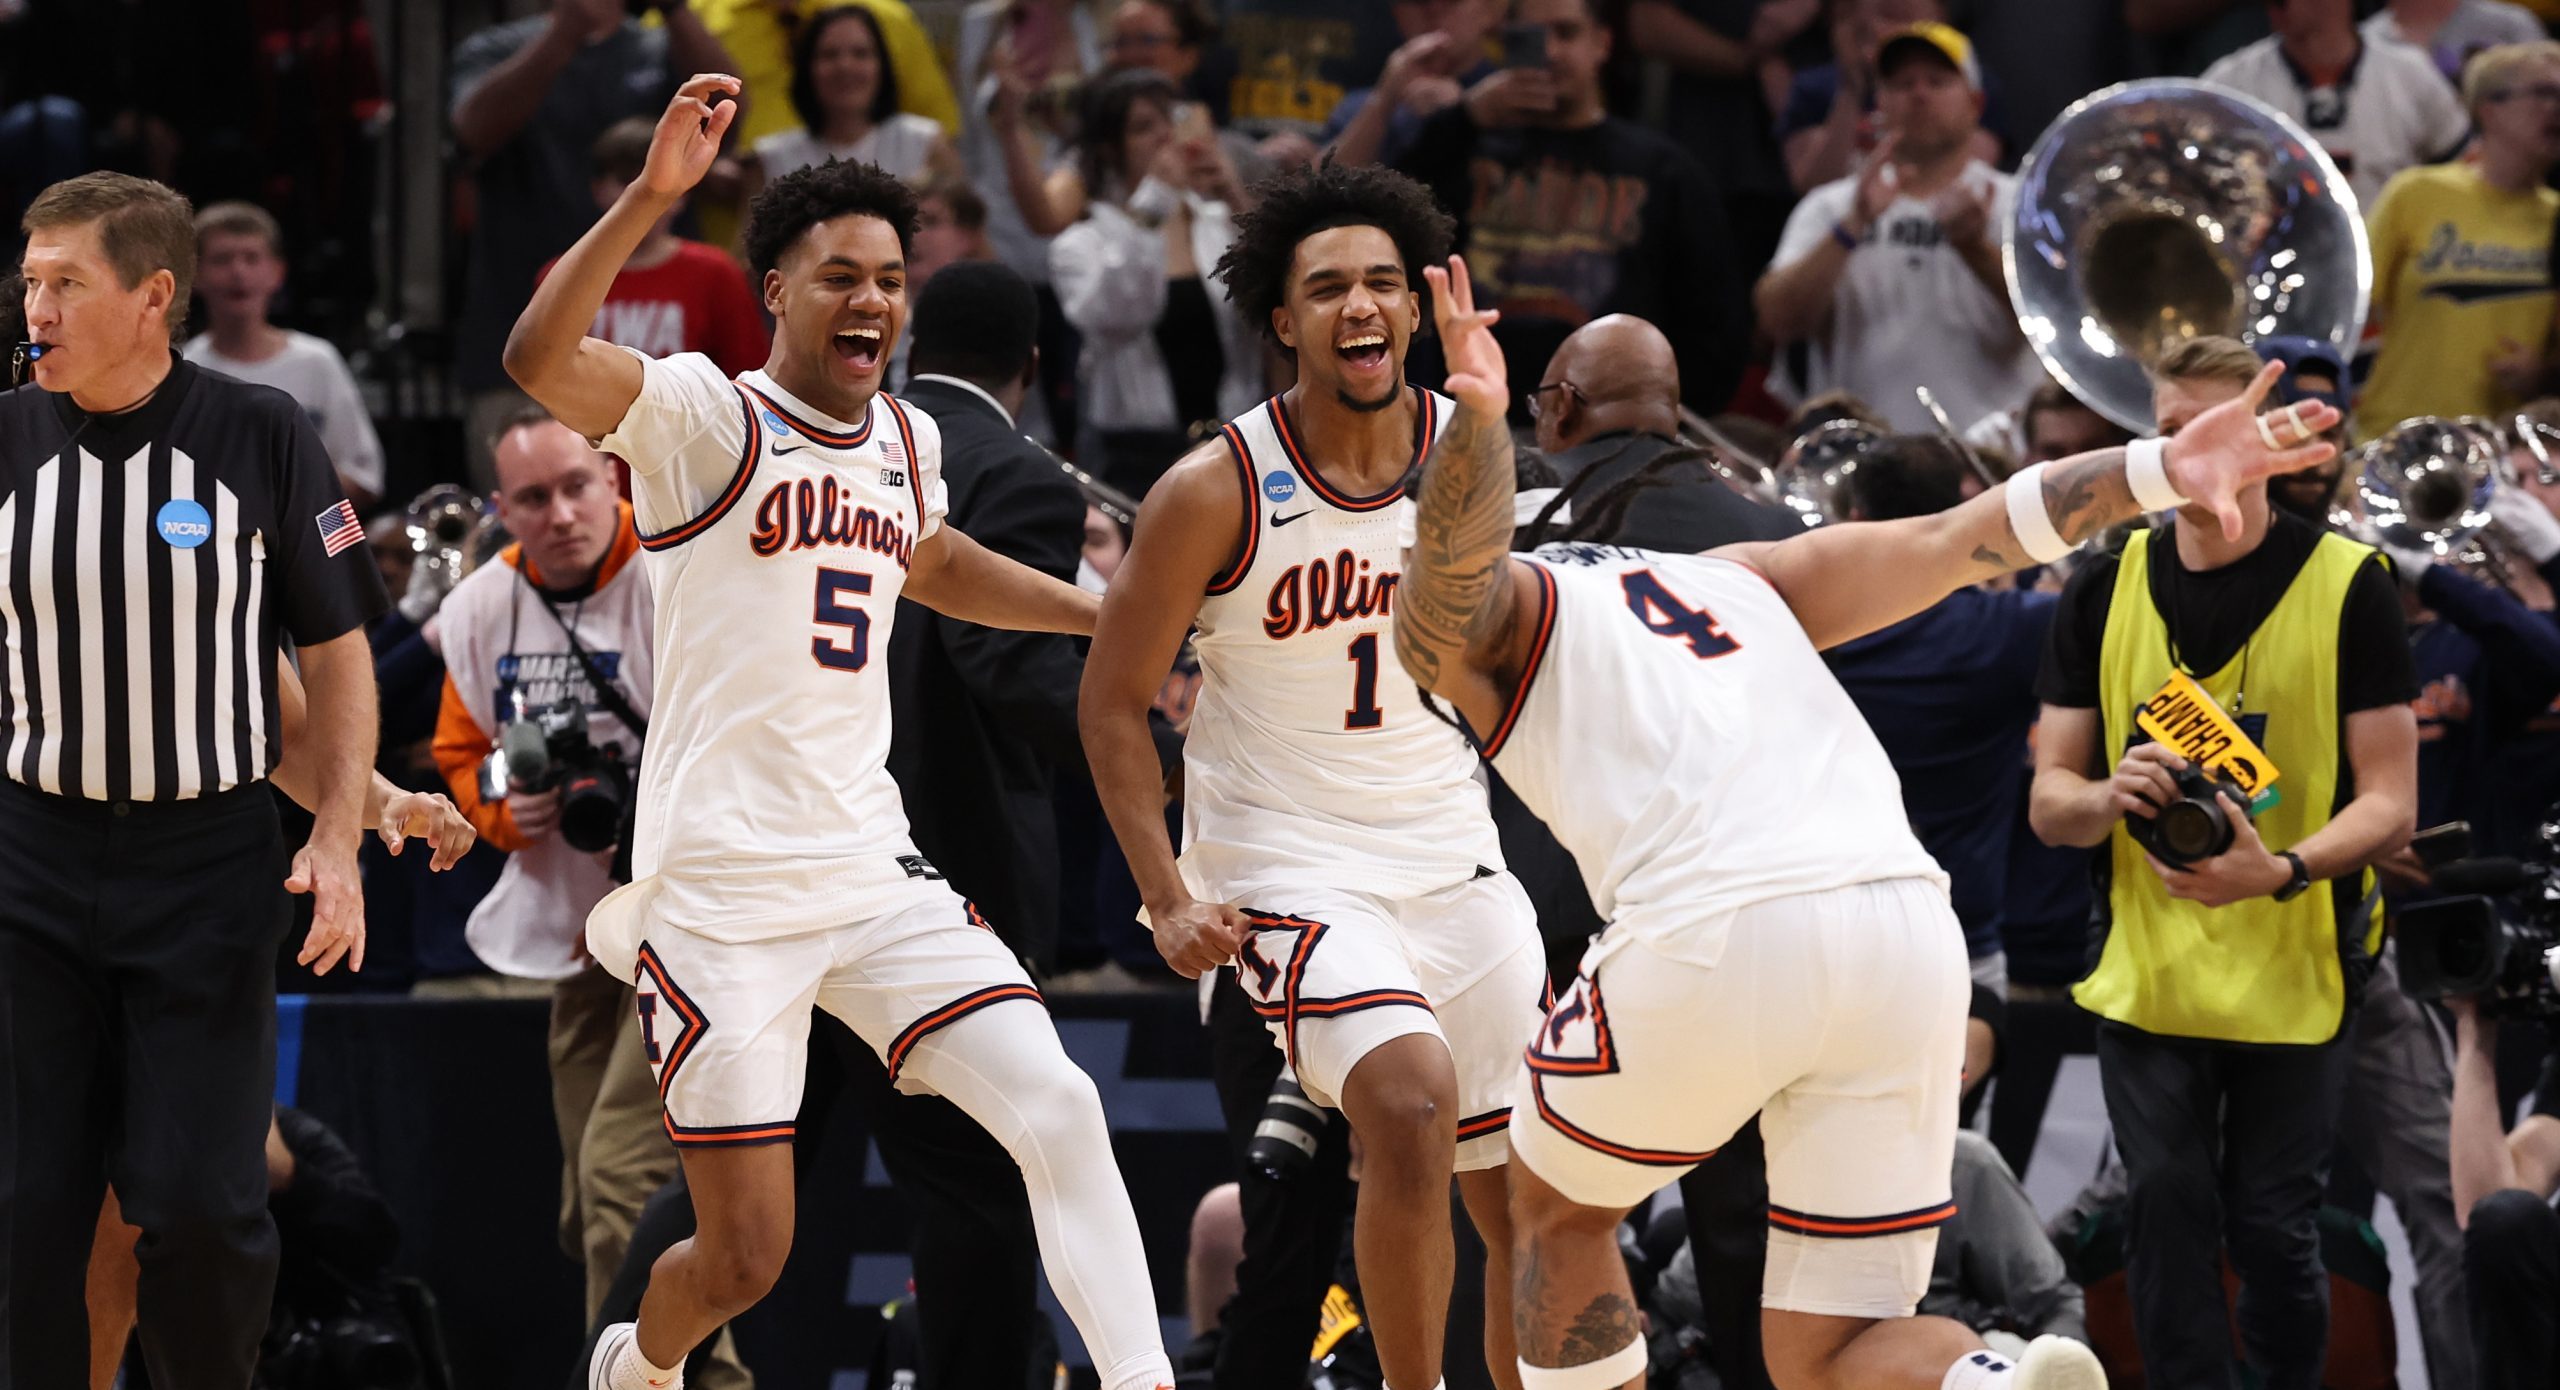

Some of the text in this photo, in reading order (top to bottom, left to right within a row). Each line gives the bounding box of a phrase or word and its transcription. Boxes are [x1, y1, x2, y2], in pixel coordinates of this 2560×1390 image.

[164, 521, 208, 537] NCAA
[750, 474, 912, 575] Illinois
[1268, 485, 1294, 495] NCAA
[811, 566, 873, 673] 5
[1263, 549, 1400, 640] Illin
[1620, 569, 1742, 660] 4
[517, 655, 584, 681] MAR
[1344, 632, 1383, 730] 1
